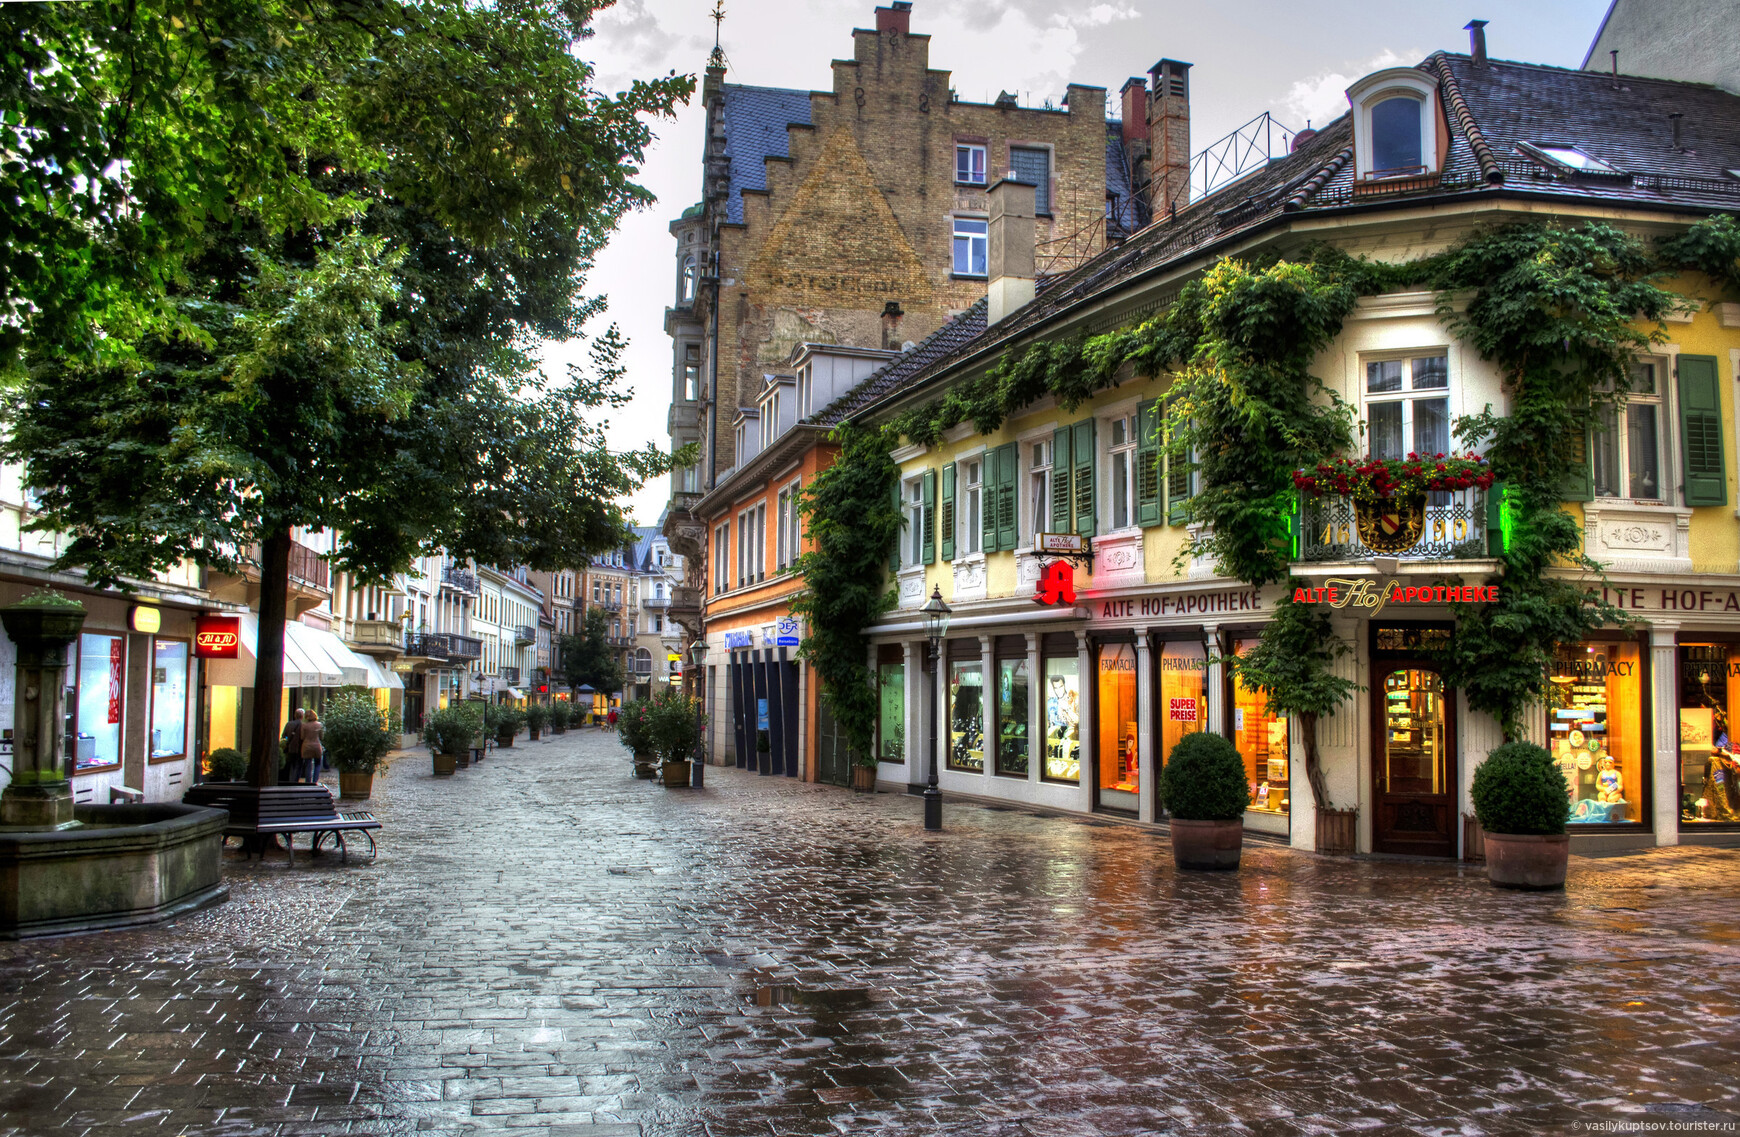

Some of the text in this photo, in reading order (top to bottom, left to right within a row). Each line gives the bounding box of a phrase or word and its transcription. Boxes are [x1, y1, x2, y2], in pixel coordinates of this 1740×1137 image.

[1319, 518, 1468, 545] 16 90
[1103, 590, 1261, 618] ALTE HOF-APOTHEKE
[1293, 577, 1500, 617] ALTE Hof APOTHEKE
[778, 622, 798, 630] DER
[1101, 658, 1136, 671] FARMACIA
[1556, 661, 1634, 676] PHARMACY
[1170, 698, 1196, 709] SUPER
[1170, 710, 1196, 721] PREISE
